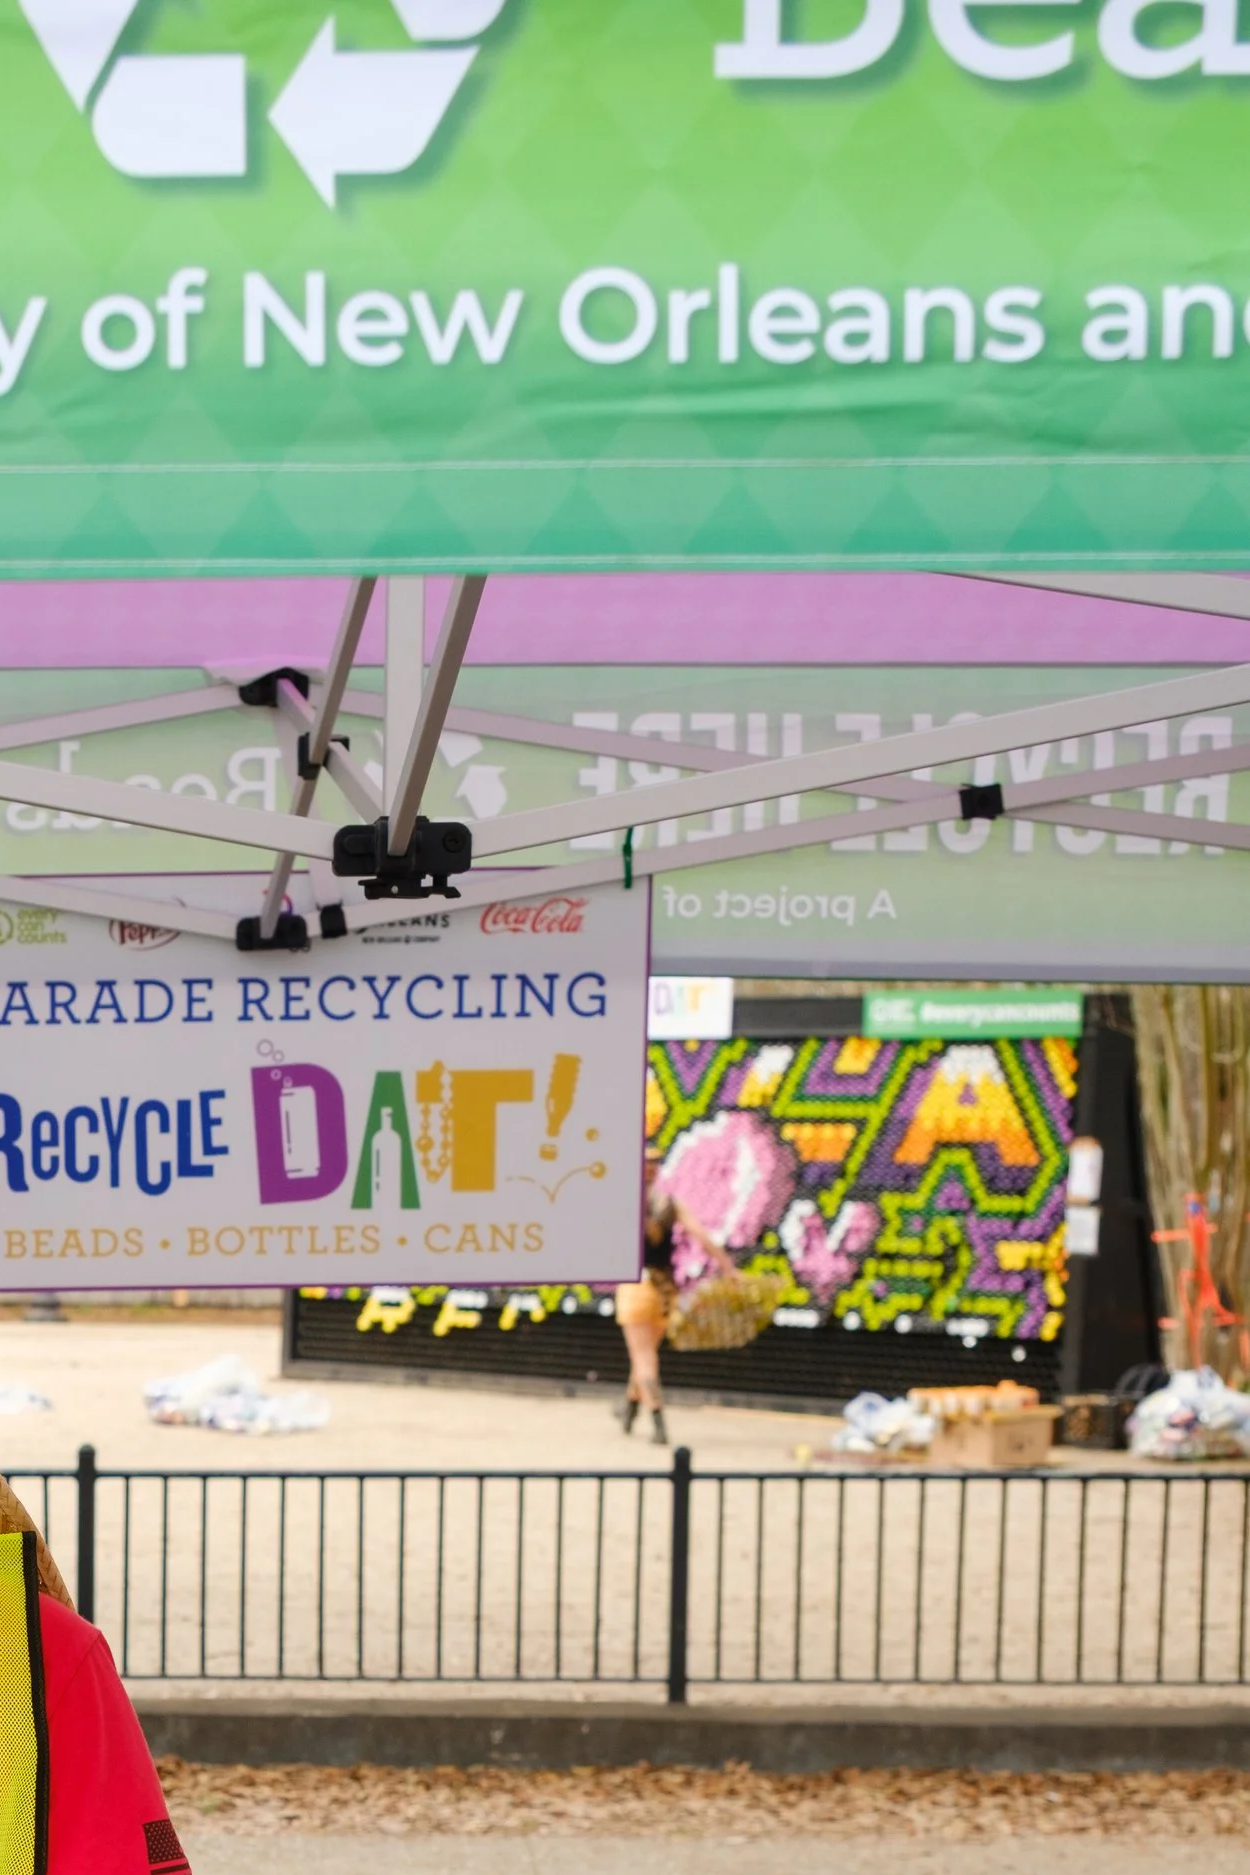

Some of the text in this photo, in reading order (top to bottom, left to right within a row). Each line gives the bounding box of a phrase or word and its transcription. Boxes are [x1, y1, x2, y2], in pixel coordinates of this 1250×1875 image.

[81, 268, 209, 370] of
[244, 271, 525, 368] New
[558, 264, 1044, 366] Orleans
[1081, 284, 1250, 362] an
[237, 972, 608, 1022] RECYCLING
[4, 1223, 544, 1260] BEADS BOTTLES CANS
